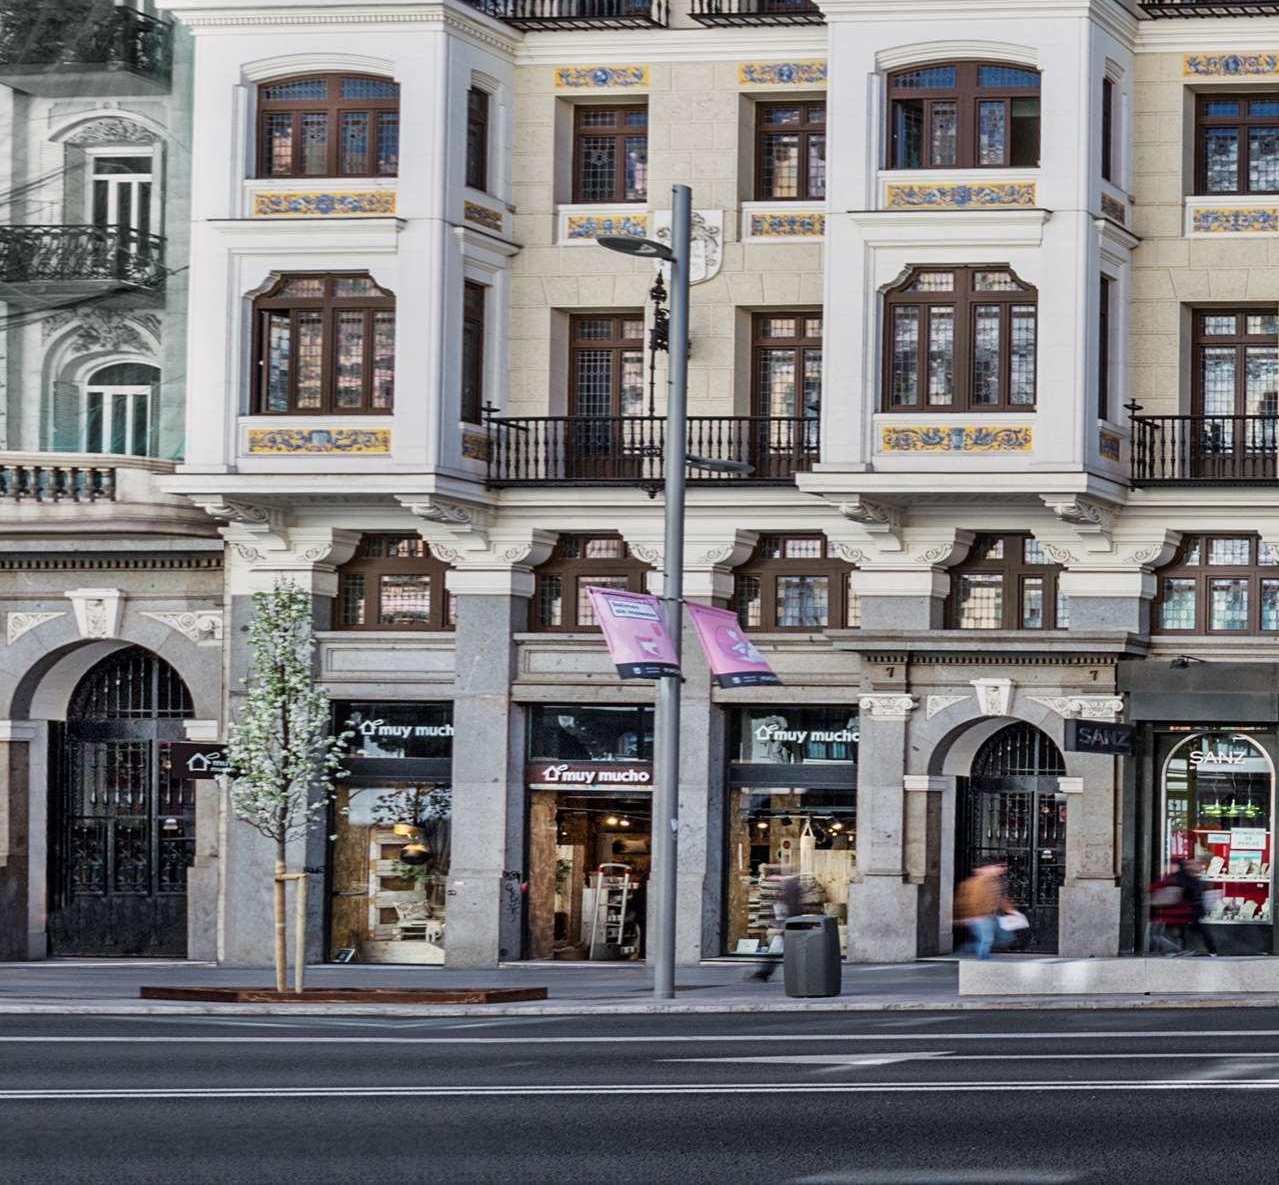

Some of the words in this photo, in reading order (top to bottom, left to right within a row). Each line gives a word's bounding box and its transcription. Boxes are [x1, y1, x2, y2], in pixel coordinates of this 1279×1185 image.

[885, 666, 896, 678] 7
[1089, 669, 1100, 681] 7
[376, 725, 412, 739] muy
[774, 731, 808, 744] muy
[1080, 727, 1130, 746] SANZ
[1190, 751, 1246, 765] SANZ
[561, 769, 597, 784] muy
[598, 767, 650, 782] mucho
